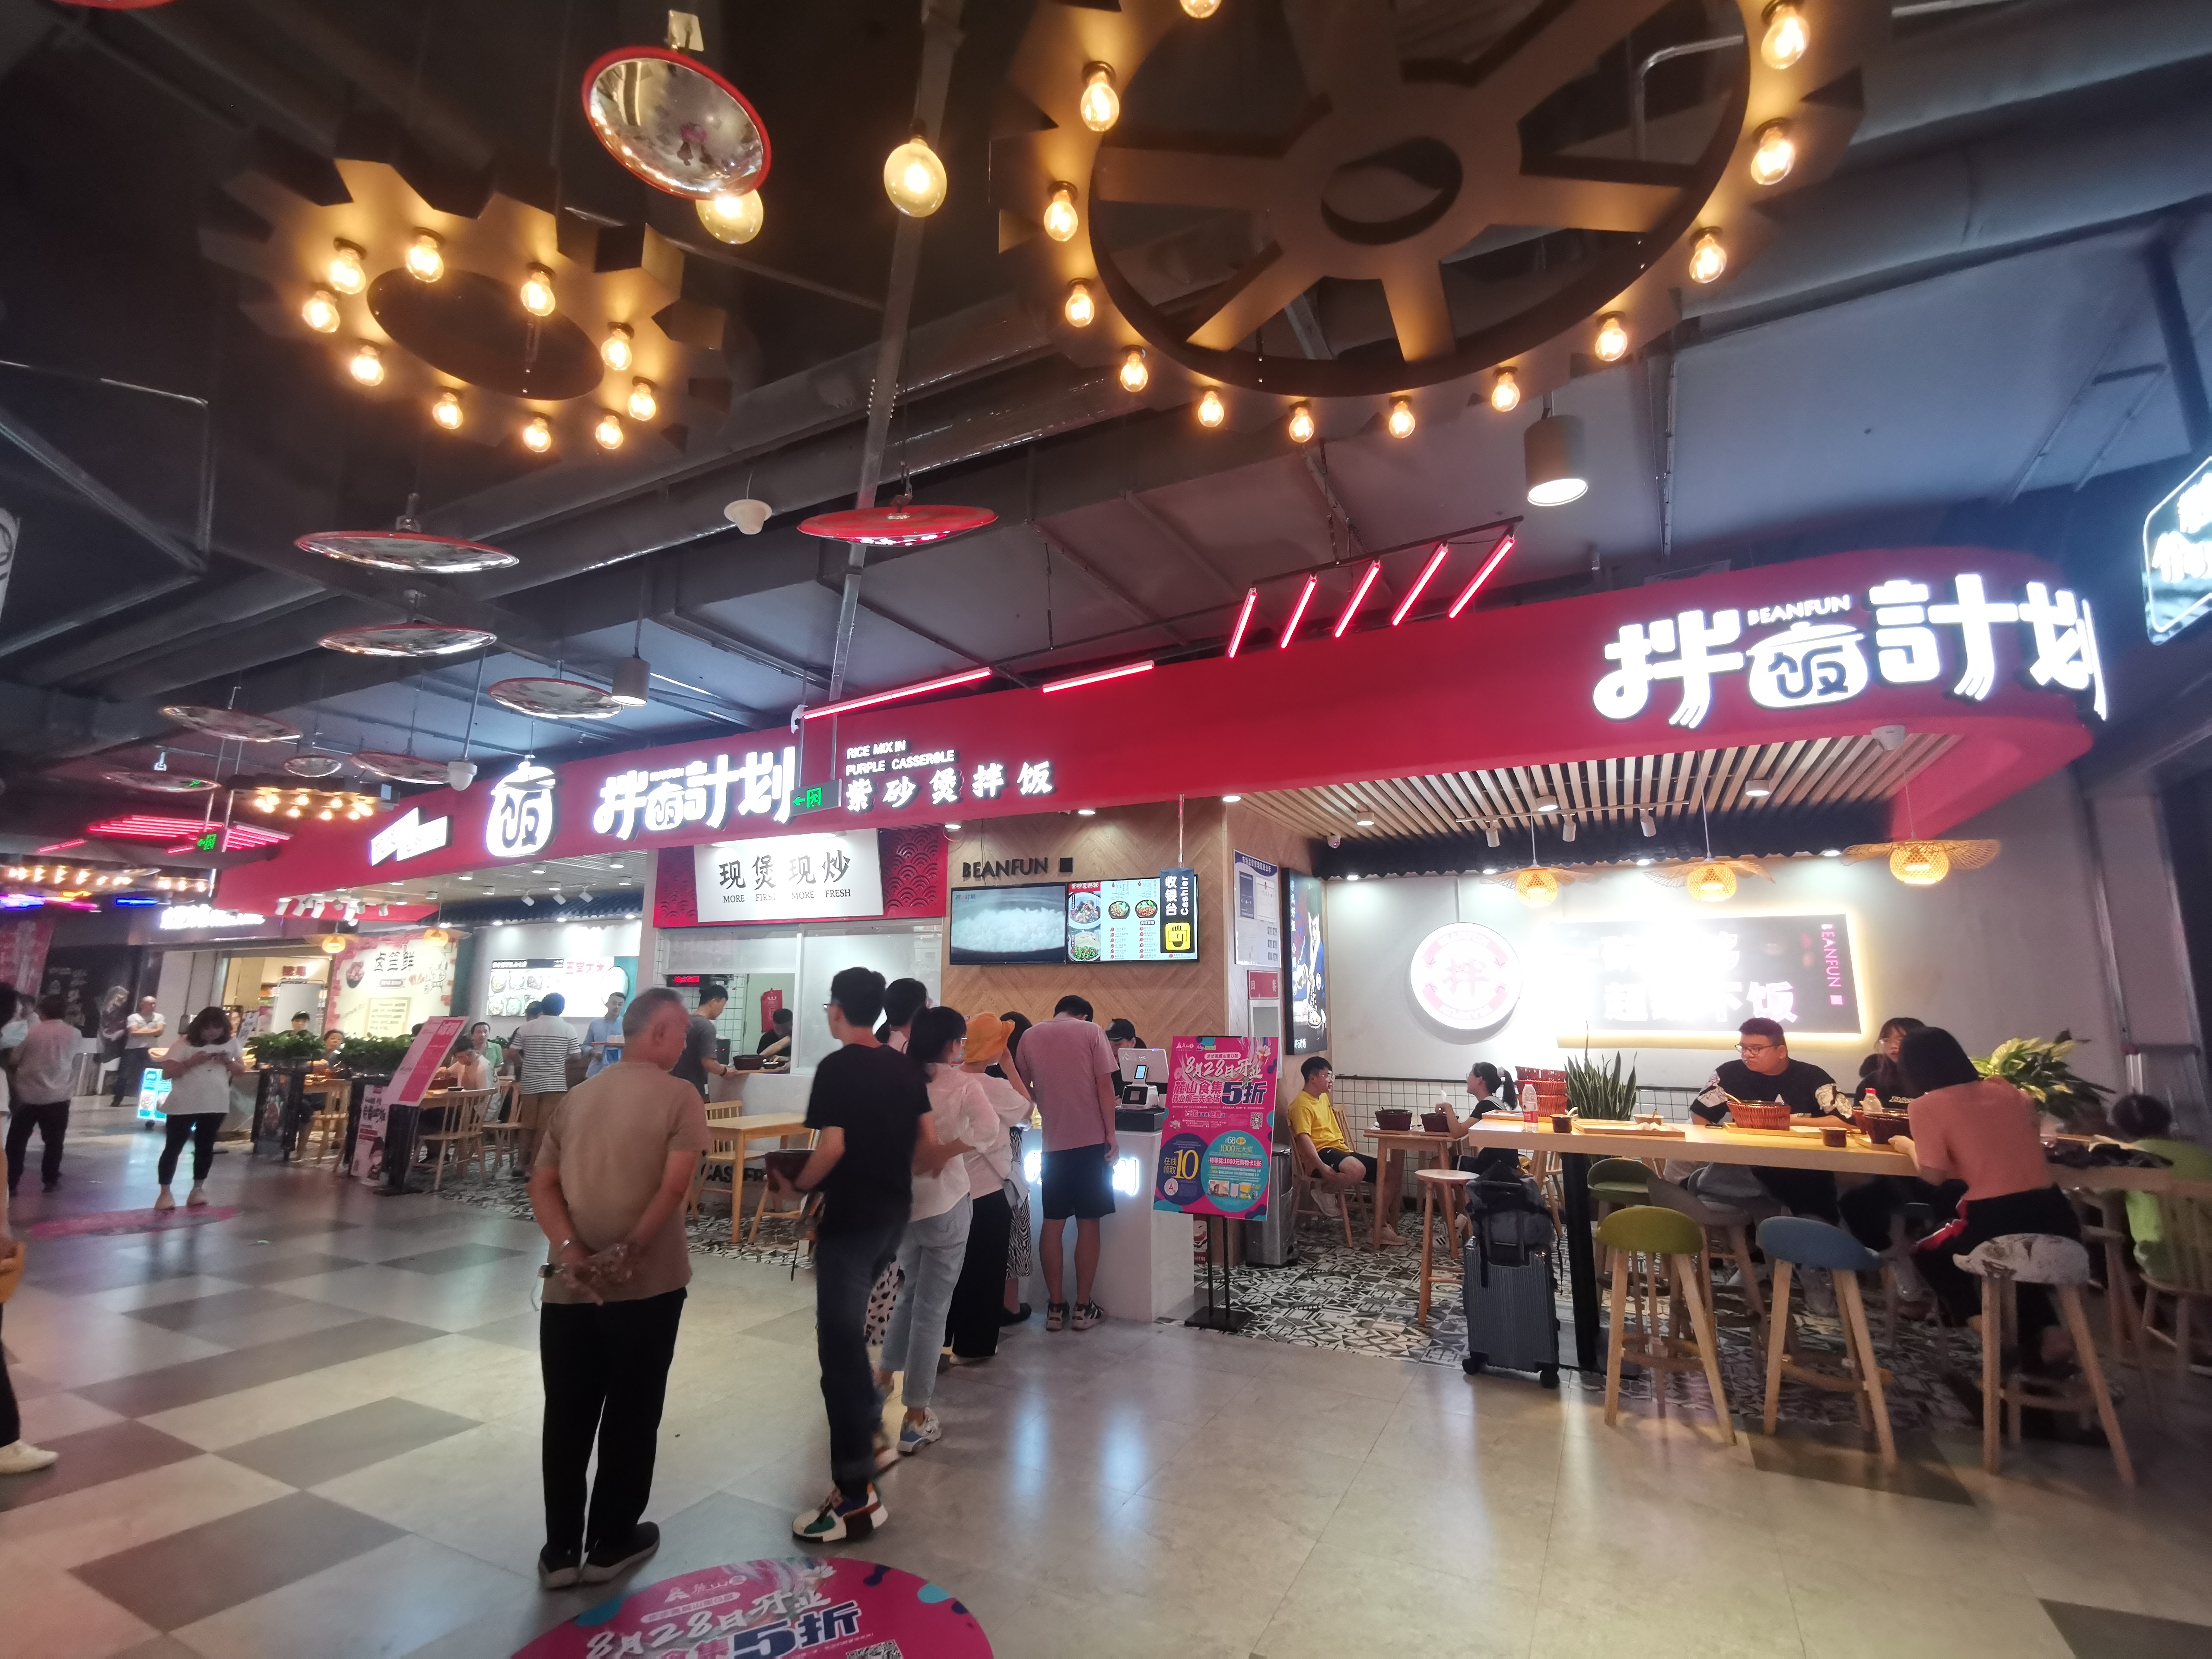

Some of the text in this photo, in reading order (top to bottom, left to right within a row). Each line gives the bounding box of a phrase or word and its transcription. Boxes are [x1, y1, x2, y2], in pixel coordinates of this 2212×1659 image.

[1748, 595, 1851, 627] BEANFUN
[846, 750, 955, 776] PURPLE CASSEROLE
[847, 740, 906, 759] RICE MIX IN
[845, 761, 1053, 812] 紫砂煲拌饭
[719, 849, 851, 890] 现煲现炒
[962, 857, 1048, 879] BEANFUN
[723, 889, 851, 903] MORE FIRST MORE FRESH
[1165, 875, 1177, 915] 收银台
[1180, 875, 1189, 915] Cashier
[1821, 924, 1841, 988] BEANFUN
[1185, 1055, 1263, 1079] 8月28日开业
[1172, 1094, 1222, 1104] 开业前三天全场
[1173, 1080, 1223, 1095] 麓山食集
[1221, 1081, 1267, 1105] 5折
[1164, 1157, 1177, 1166] 在线
[1171, 1149, 1199, 1180] 10
[586, 1588, 832, 1659] 8月28日开业
[733, 1599, 862, 1659] 5折
